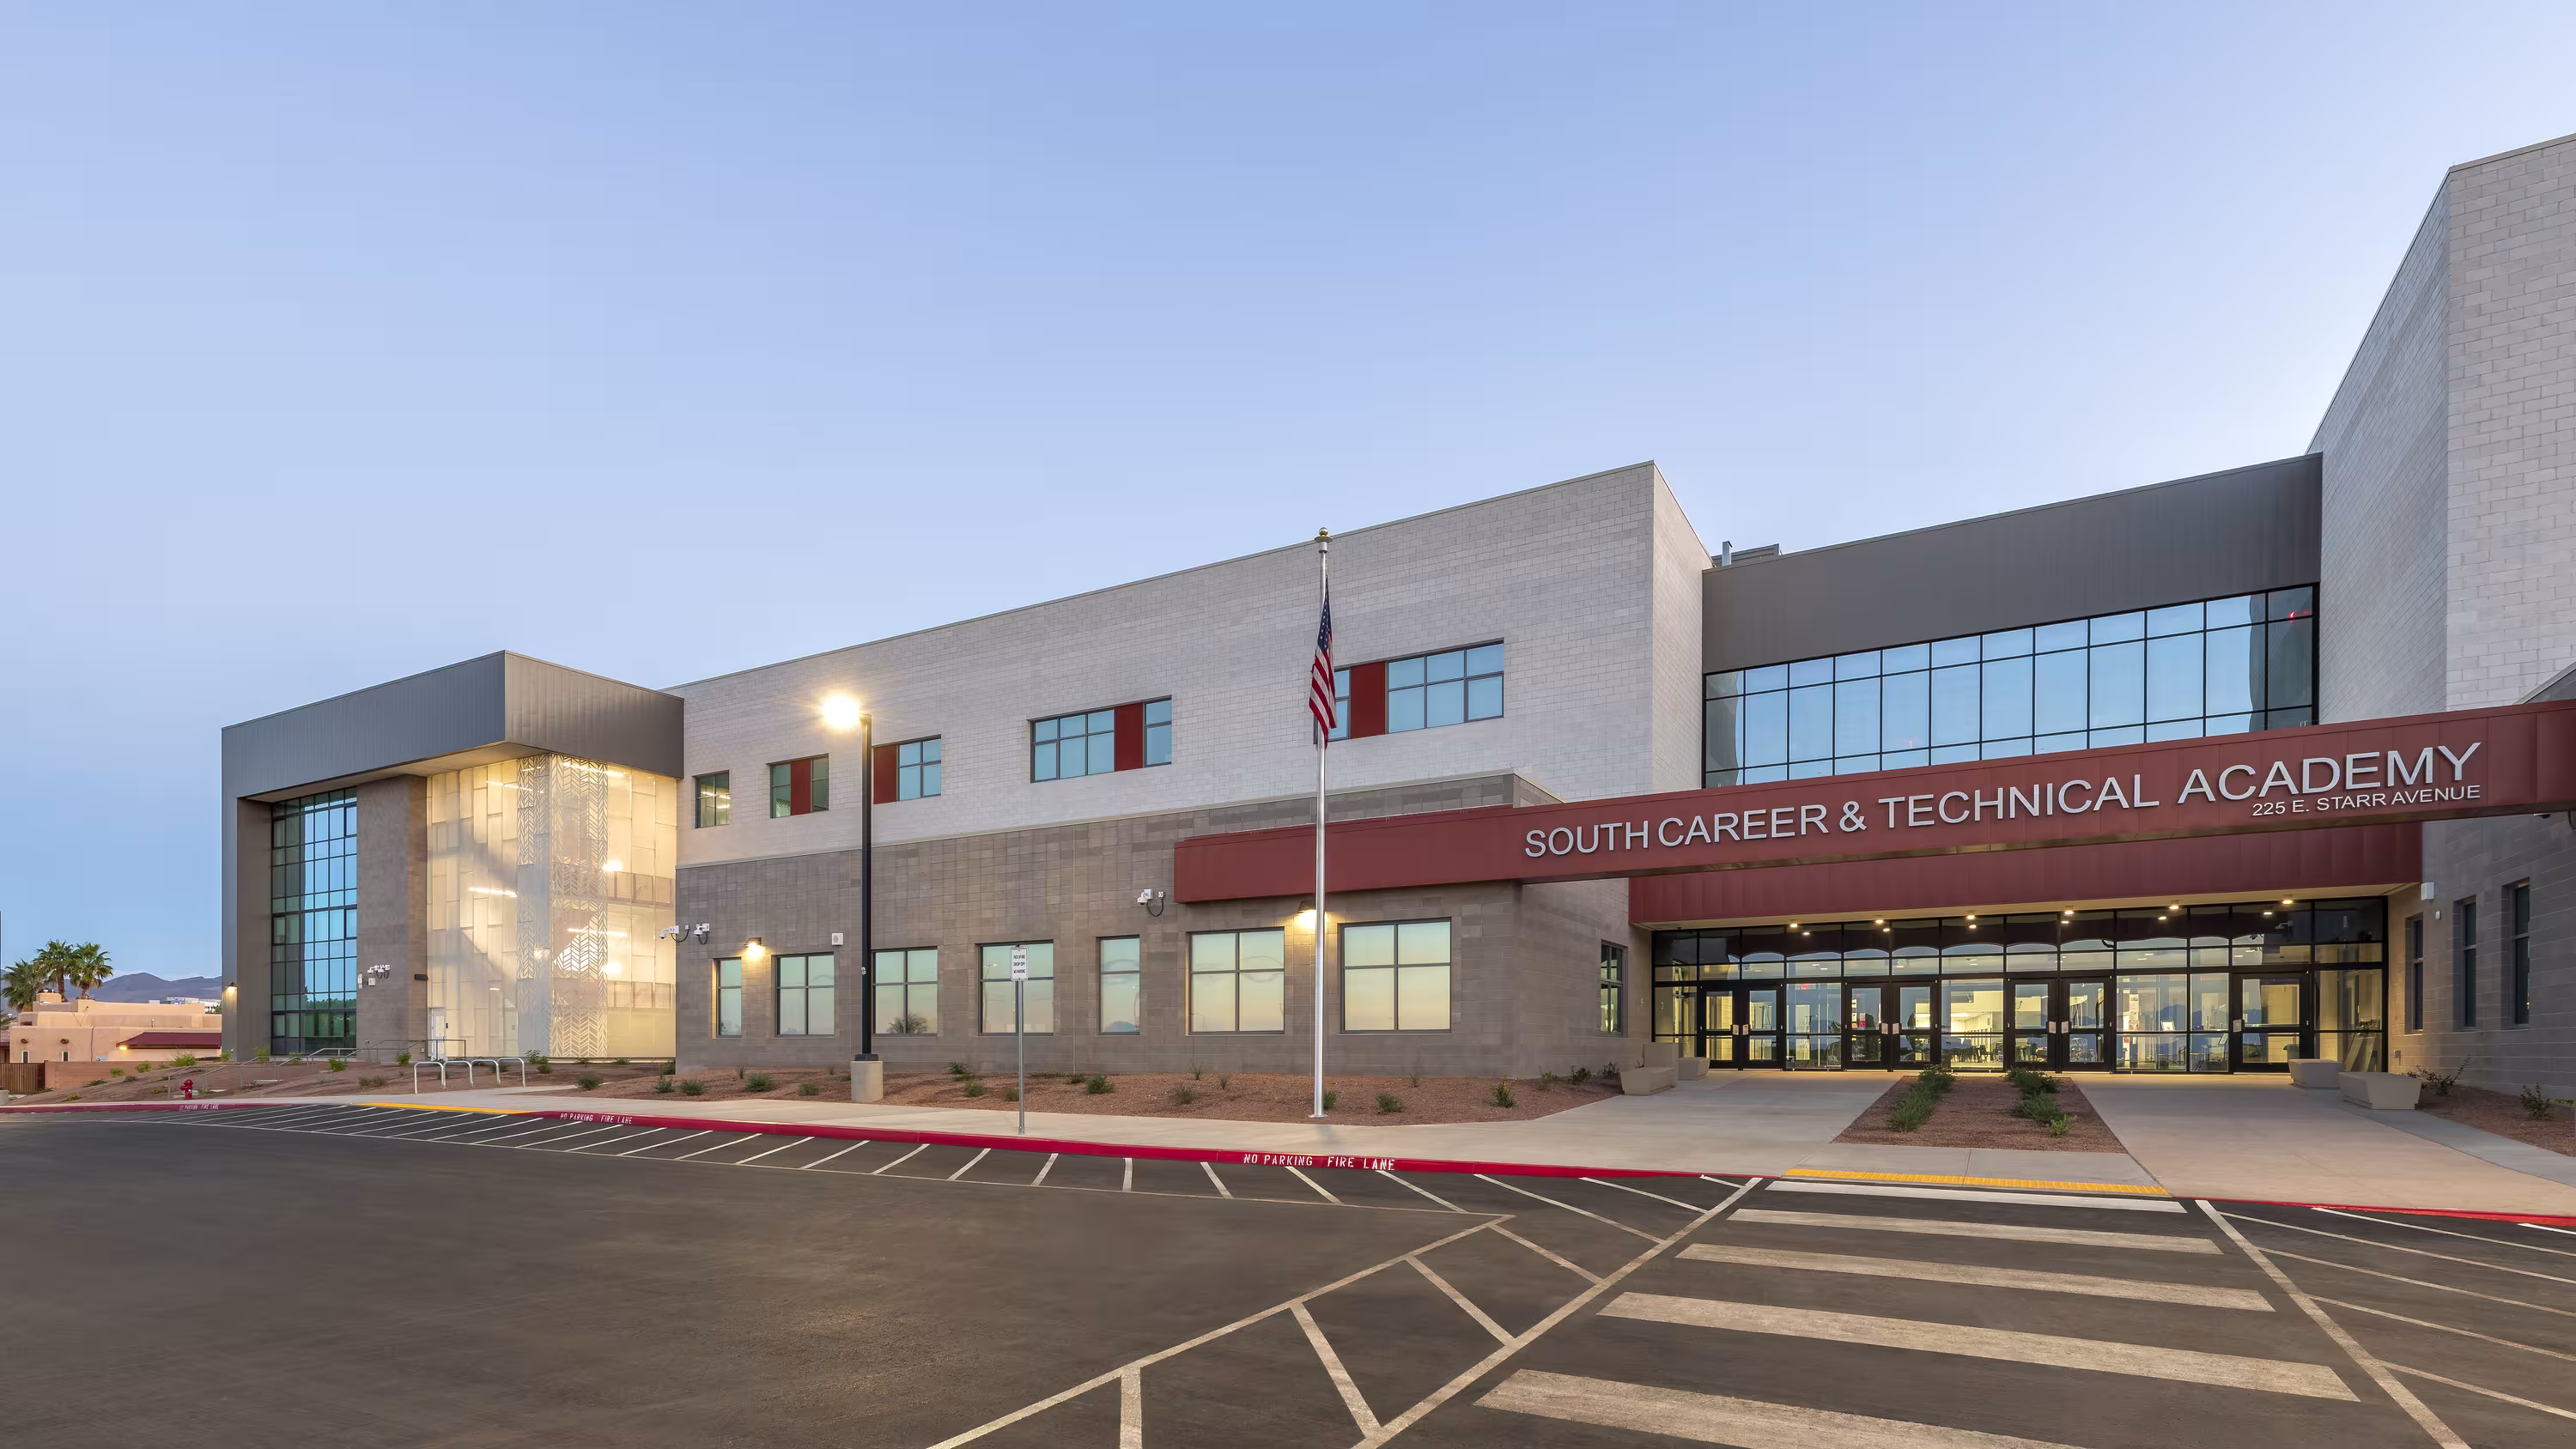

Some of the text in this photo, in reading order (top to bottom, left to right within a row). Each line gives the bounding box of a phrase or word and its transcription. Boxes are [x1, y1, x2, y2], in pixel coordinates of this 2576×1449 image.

[1525, 742, 2482, 858] SOUTH CAREER & TECHNICAL ACADEMY
[2251, 785, 2482, 816] 225 E. STARR AVENUE
[569, 1113, 593, 1121] PARKING
[600, 1114, 615, 1123] FIRE
[617, 1116, 633, 1125] LANE
[1243, 1153, 1395, 1171] NO PARKING FIRE LANE
